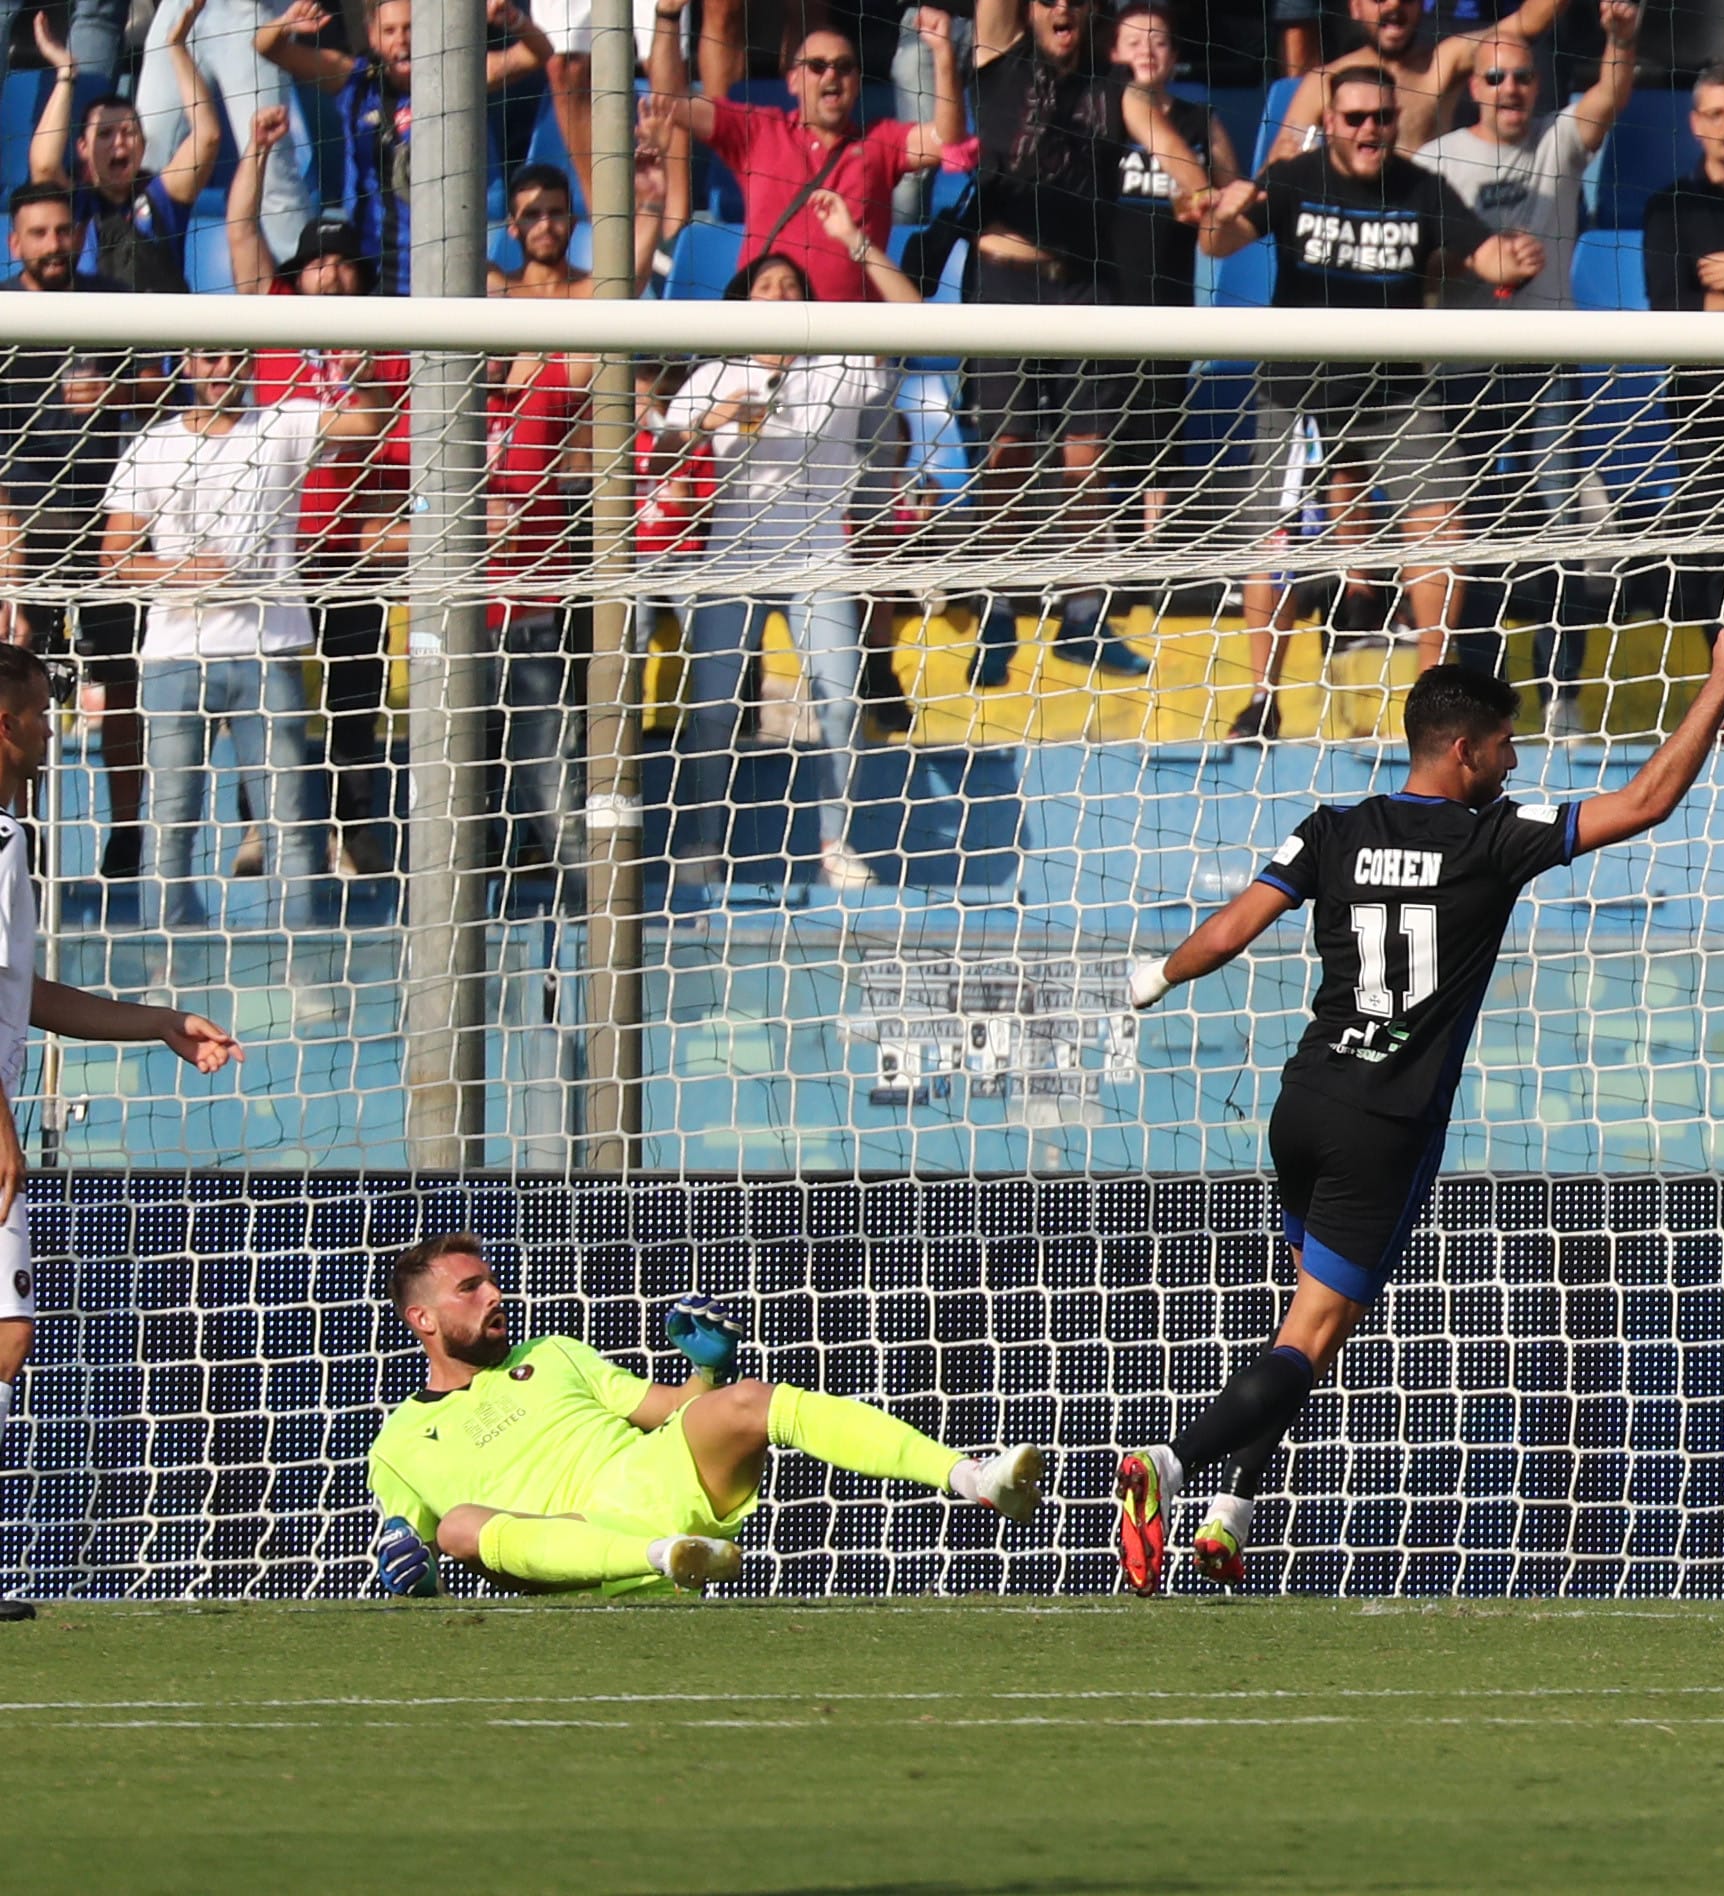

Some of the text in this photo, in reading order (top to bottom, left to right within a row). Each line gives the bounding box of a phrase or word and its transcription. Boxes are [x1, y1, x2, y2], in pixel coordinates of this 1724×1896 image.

[1296, 212, 1419, 246] PISA NON
[1303, 238, 1415, 272] SI PIEGA
[1354, 848, 1443, 887] COHEN
[1350, 903, 1438, 1019] 11
